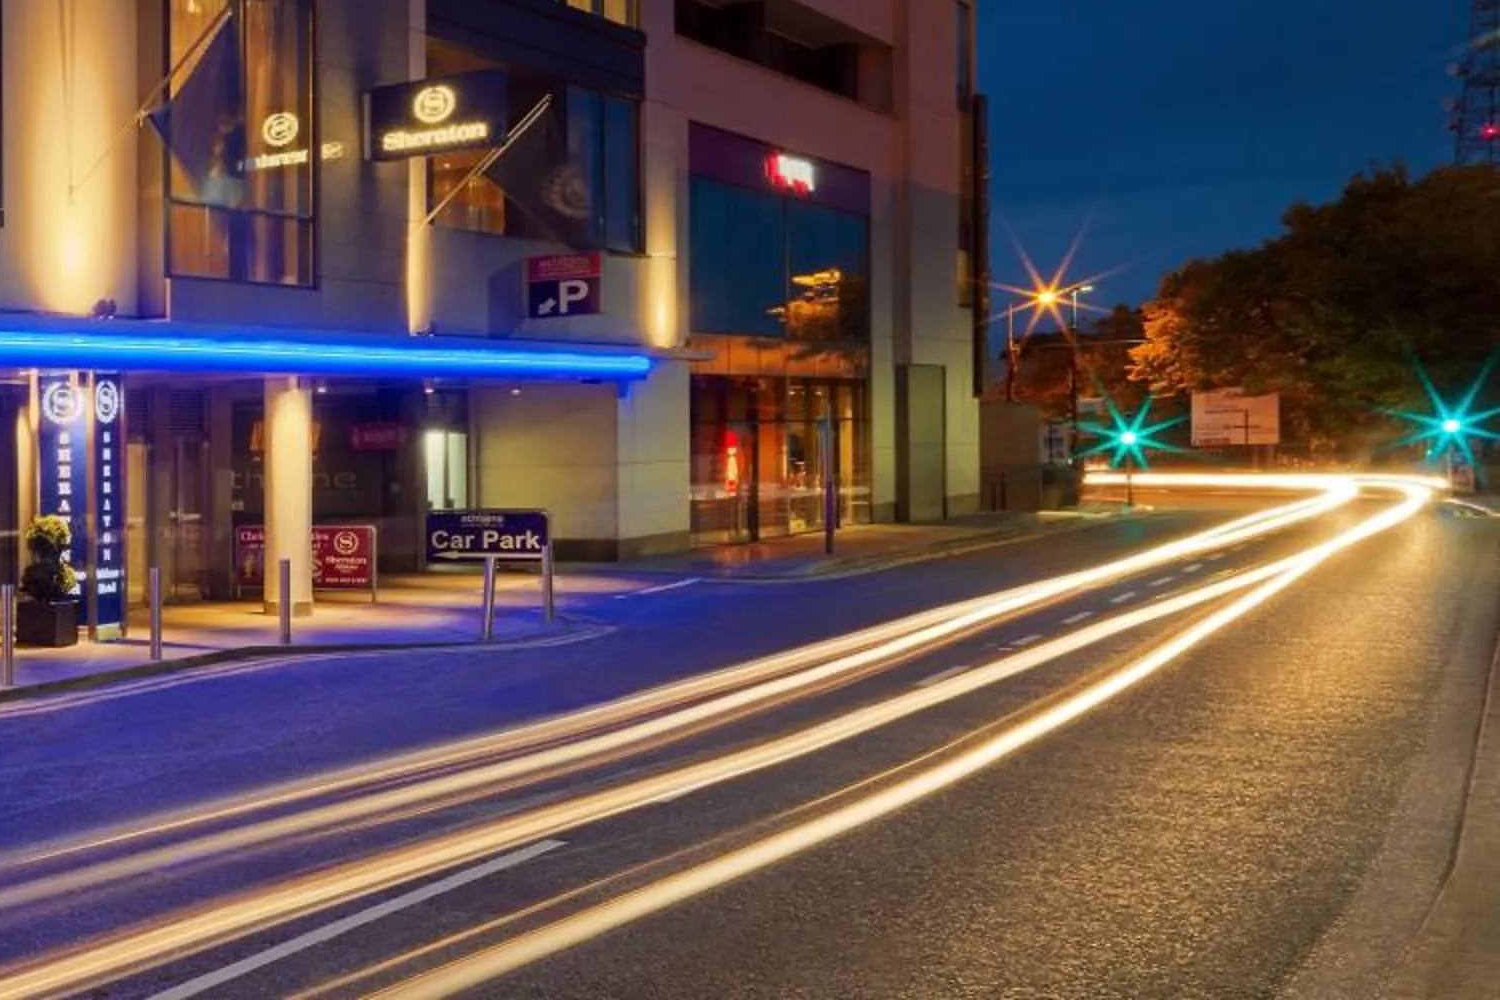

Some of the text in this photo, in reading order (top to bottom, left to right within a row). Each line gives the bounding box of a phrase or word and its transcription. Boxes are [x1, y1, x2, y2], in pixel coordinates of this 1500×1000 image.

[382, 122, 487, 151] Sheraton
[560, 280, 588, 313] P
[103, 432, 111, 560] SHERATON
[431, 529, 540, 549] Car Park
